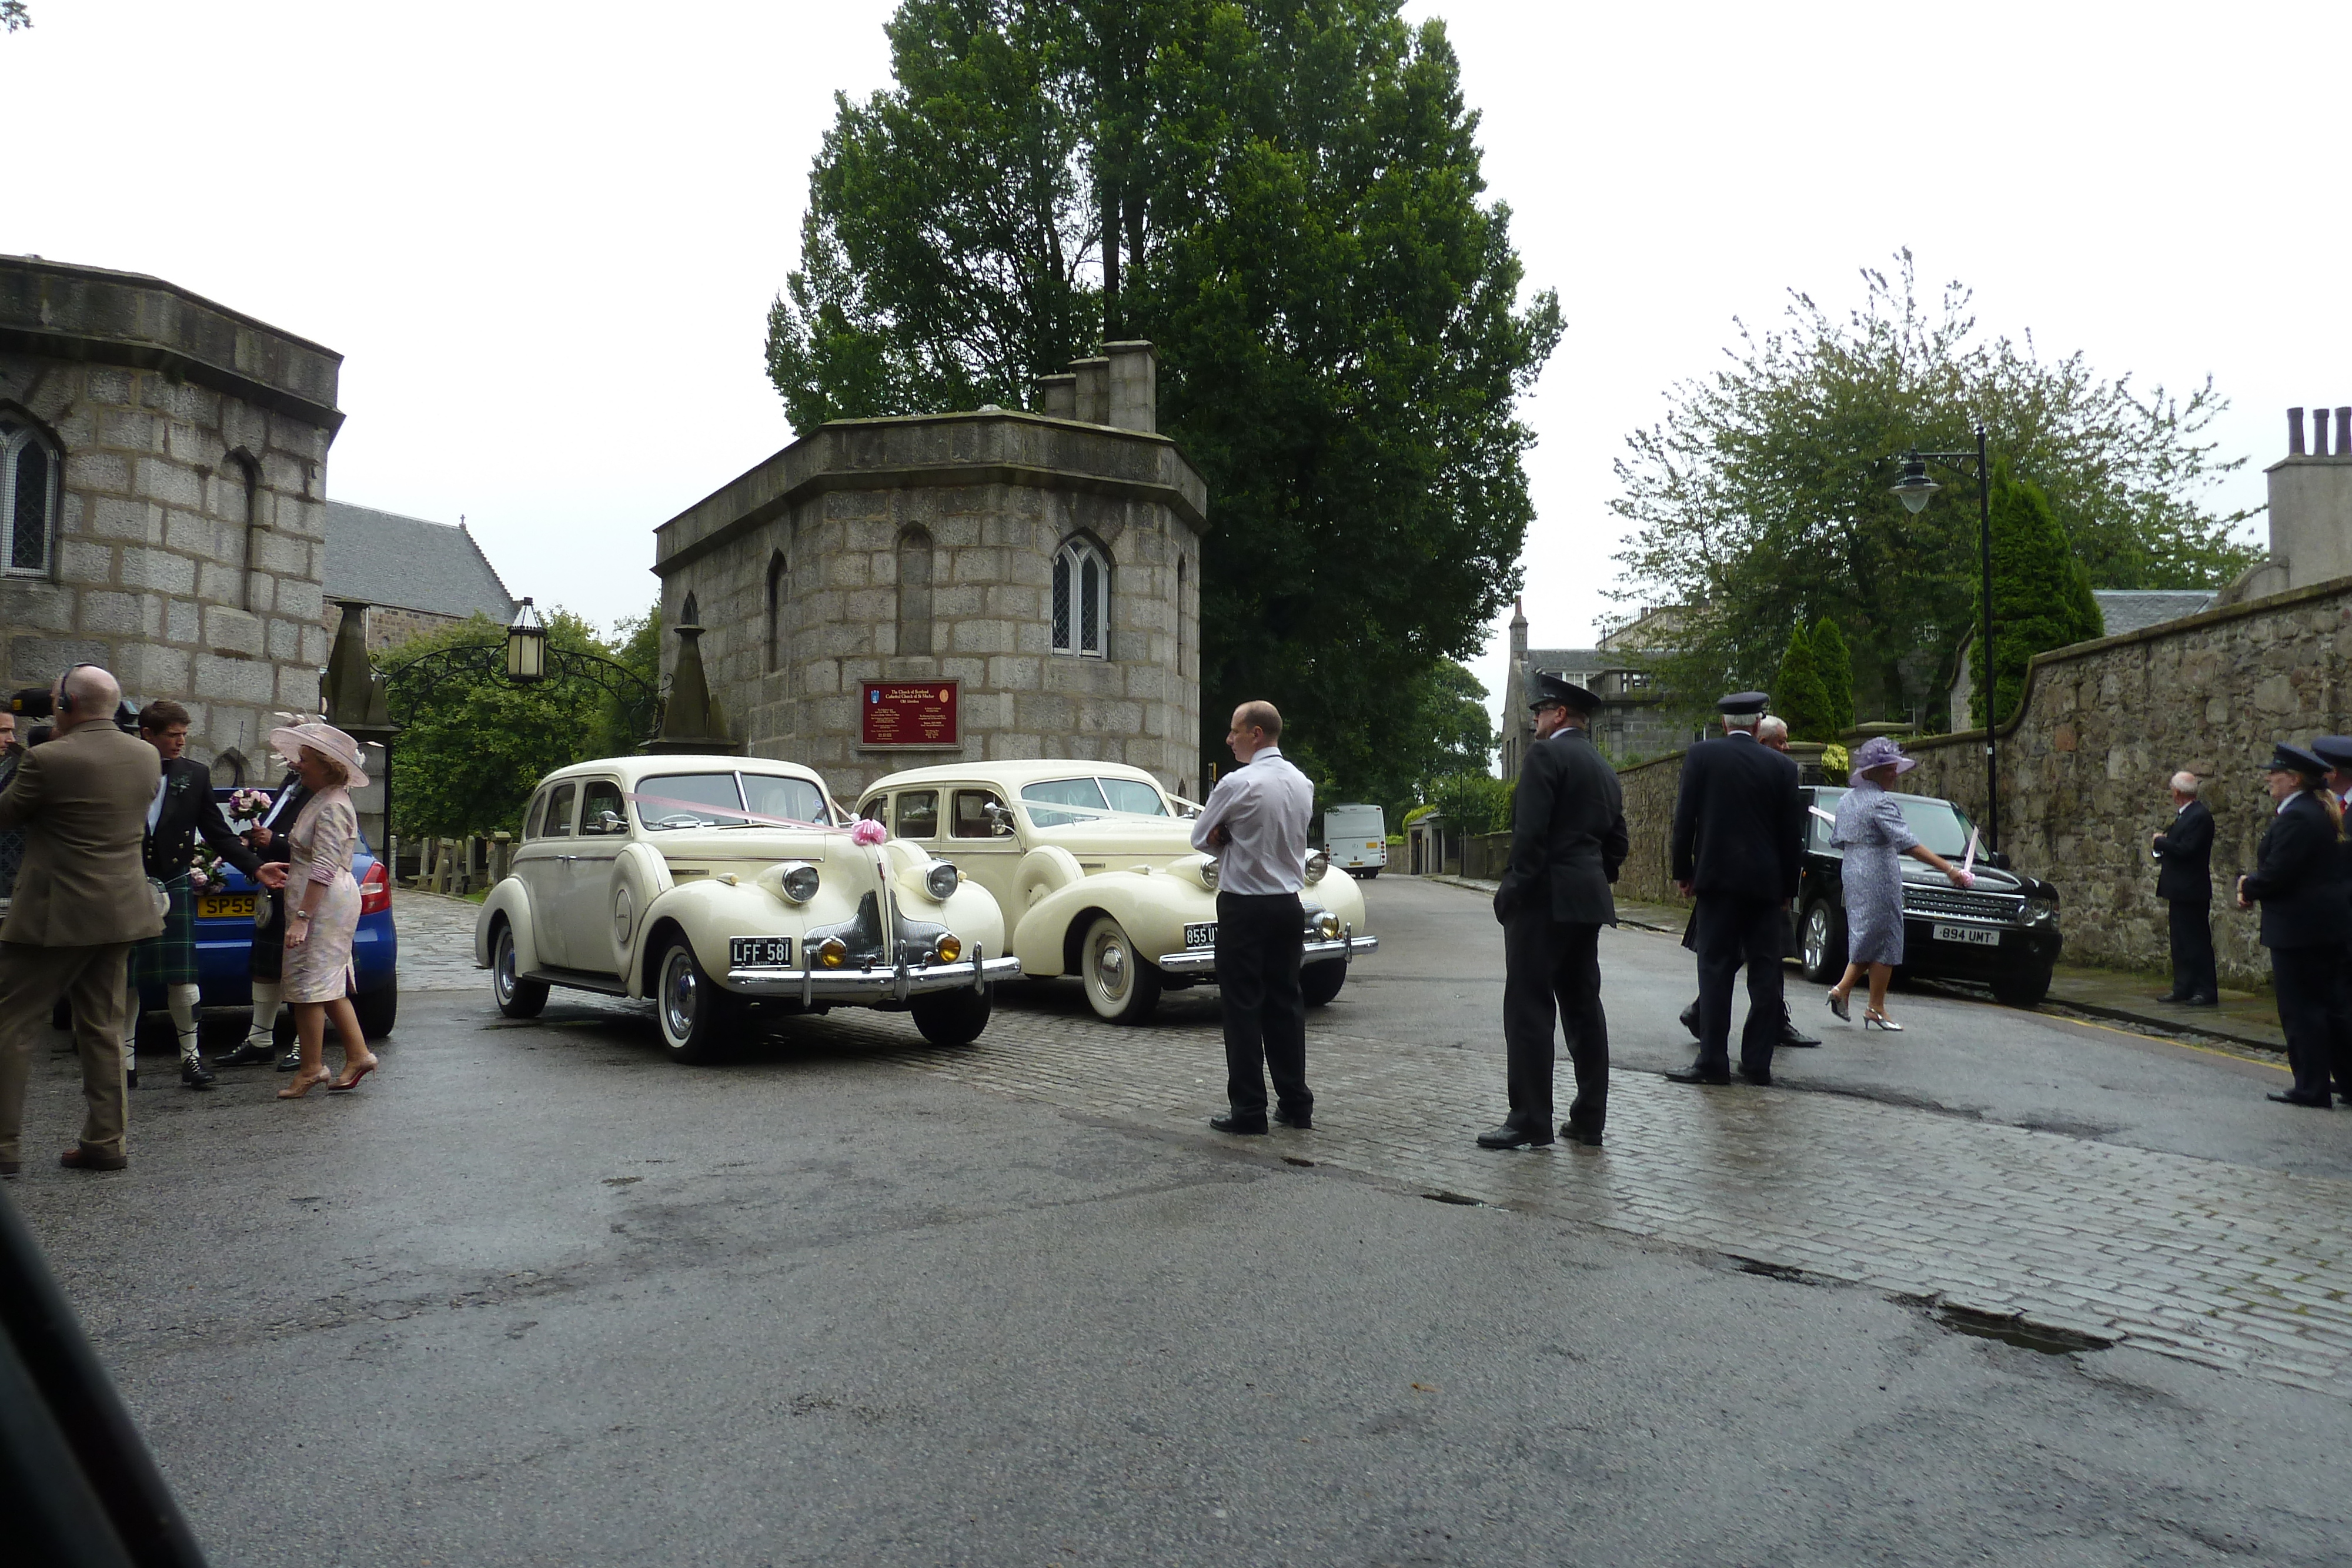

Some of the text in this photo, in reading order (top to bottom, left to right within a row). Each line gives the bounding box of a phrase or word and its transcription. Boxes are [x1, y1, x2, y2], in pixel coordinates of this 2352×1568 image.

[207, 898, 255, 914] SP59
[1943, 928, 1992, 943] 894 UMT
[734, 944, 789, 962] LFF 581
